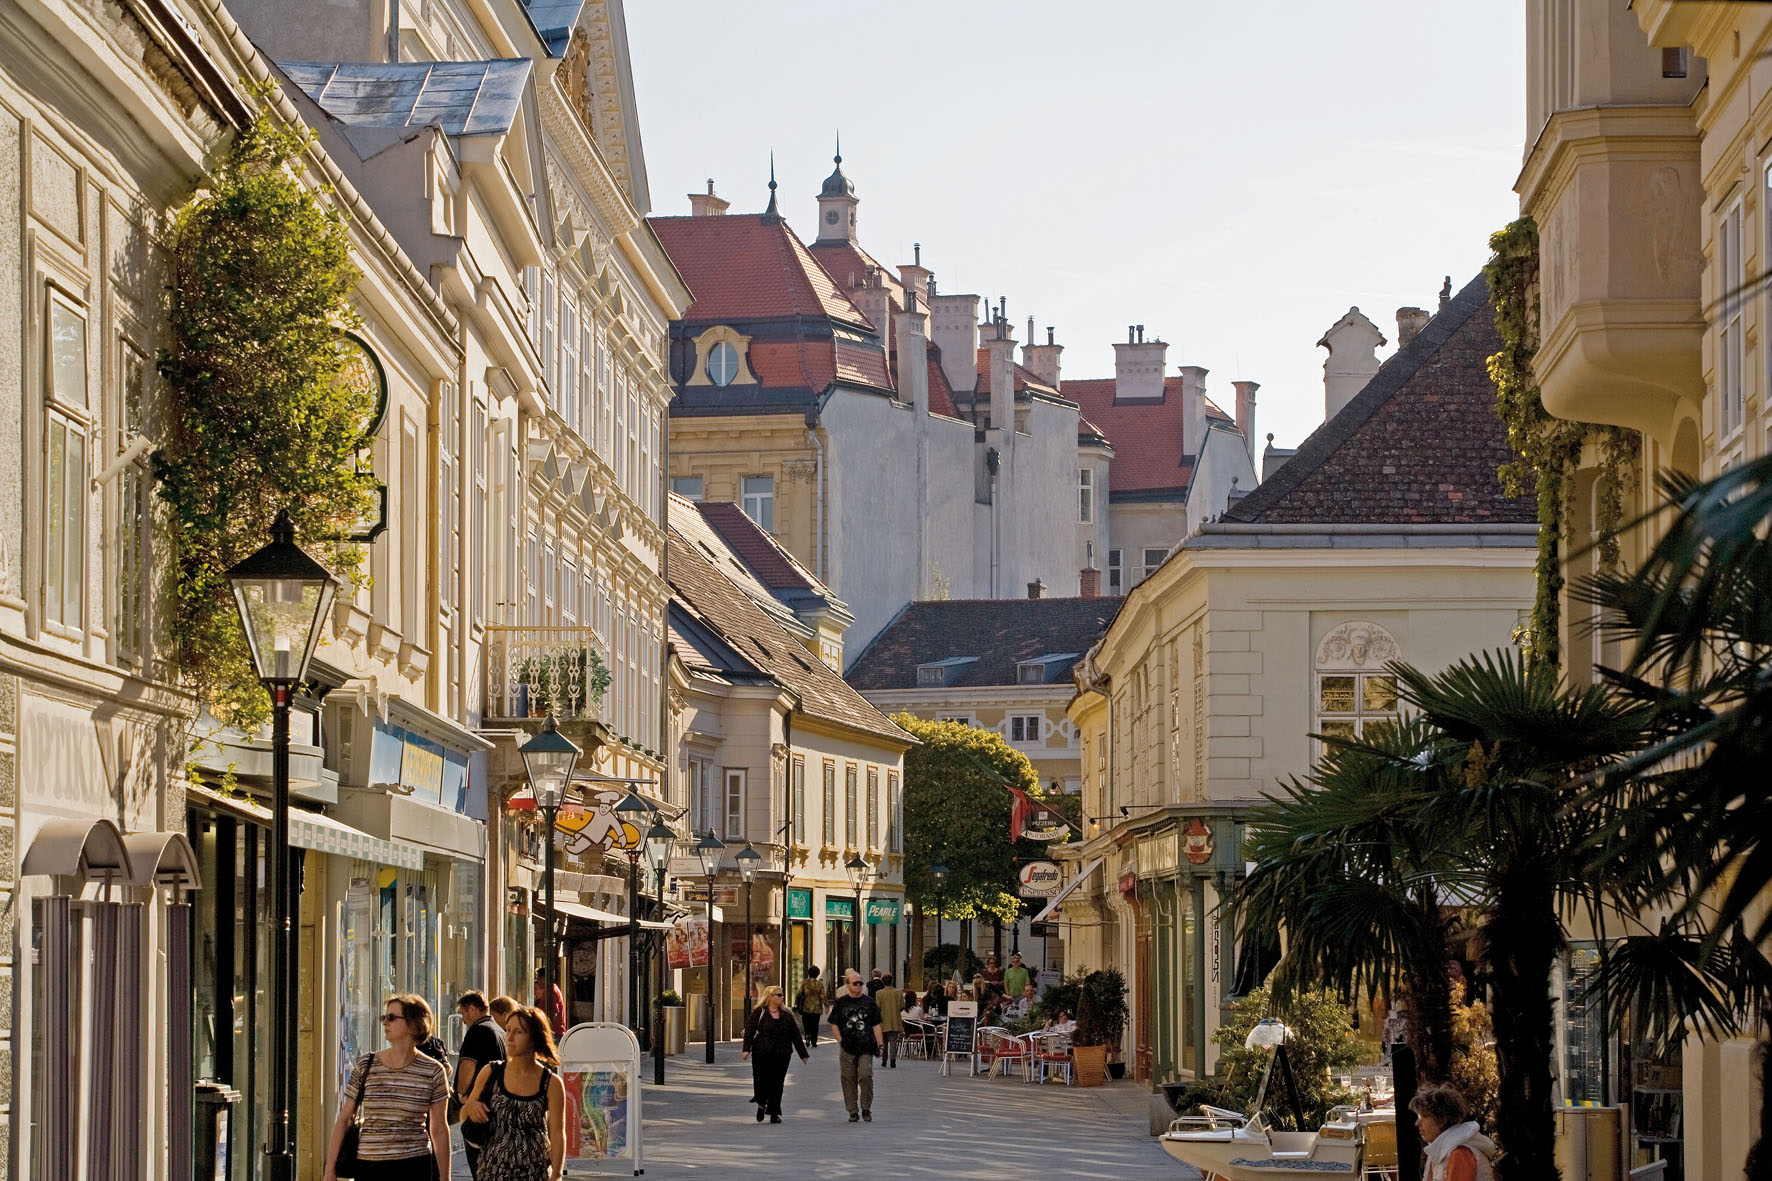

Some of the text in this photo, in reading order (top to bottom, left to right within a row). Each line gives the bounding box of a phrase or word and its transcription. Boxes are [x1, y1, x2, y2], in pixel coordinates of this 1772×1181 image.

[1024, 866, 1059, 883] Segafredo
[1022, 888, 1060, 896] ESPRESSO
[868, 905, 898, 917] PEARLE
